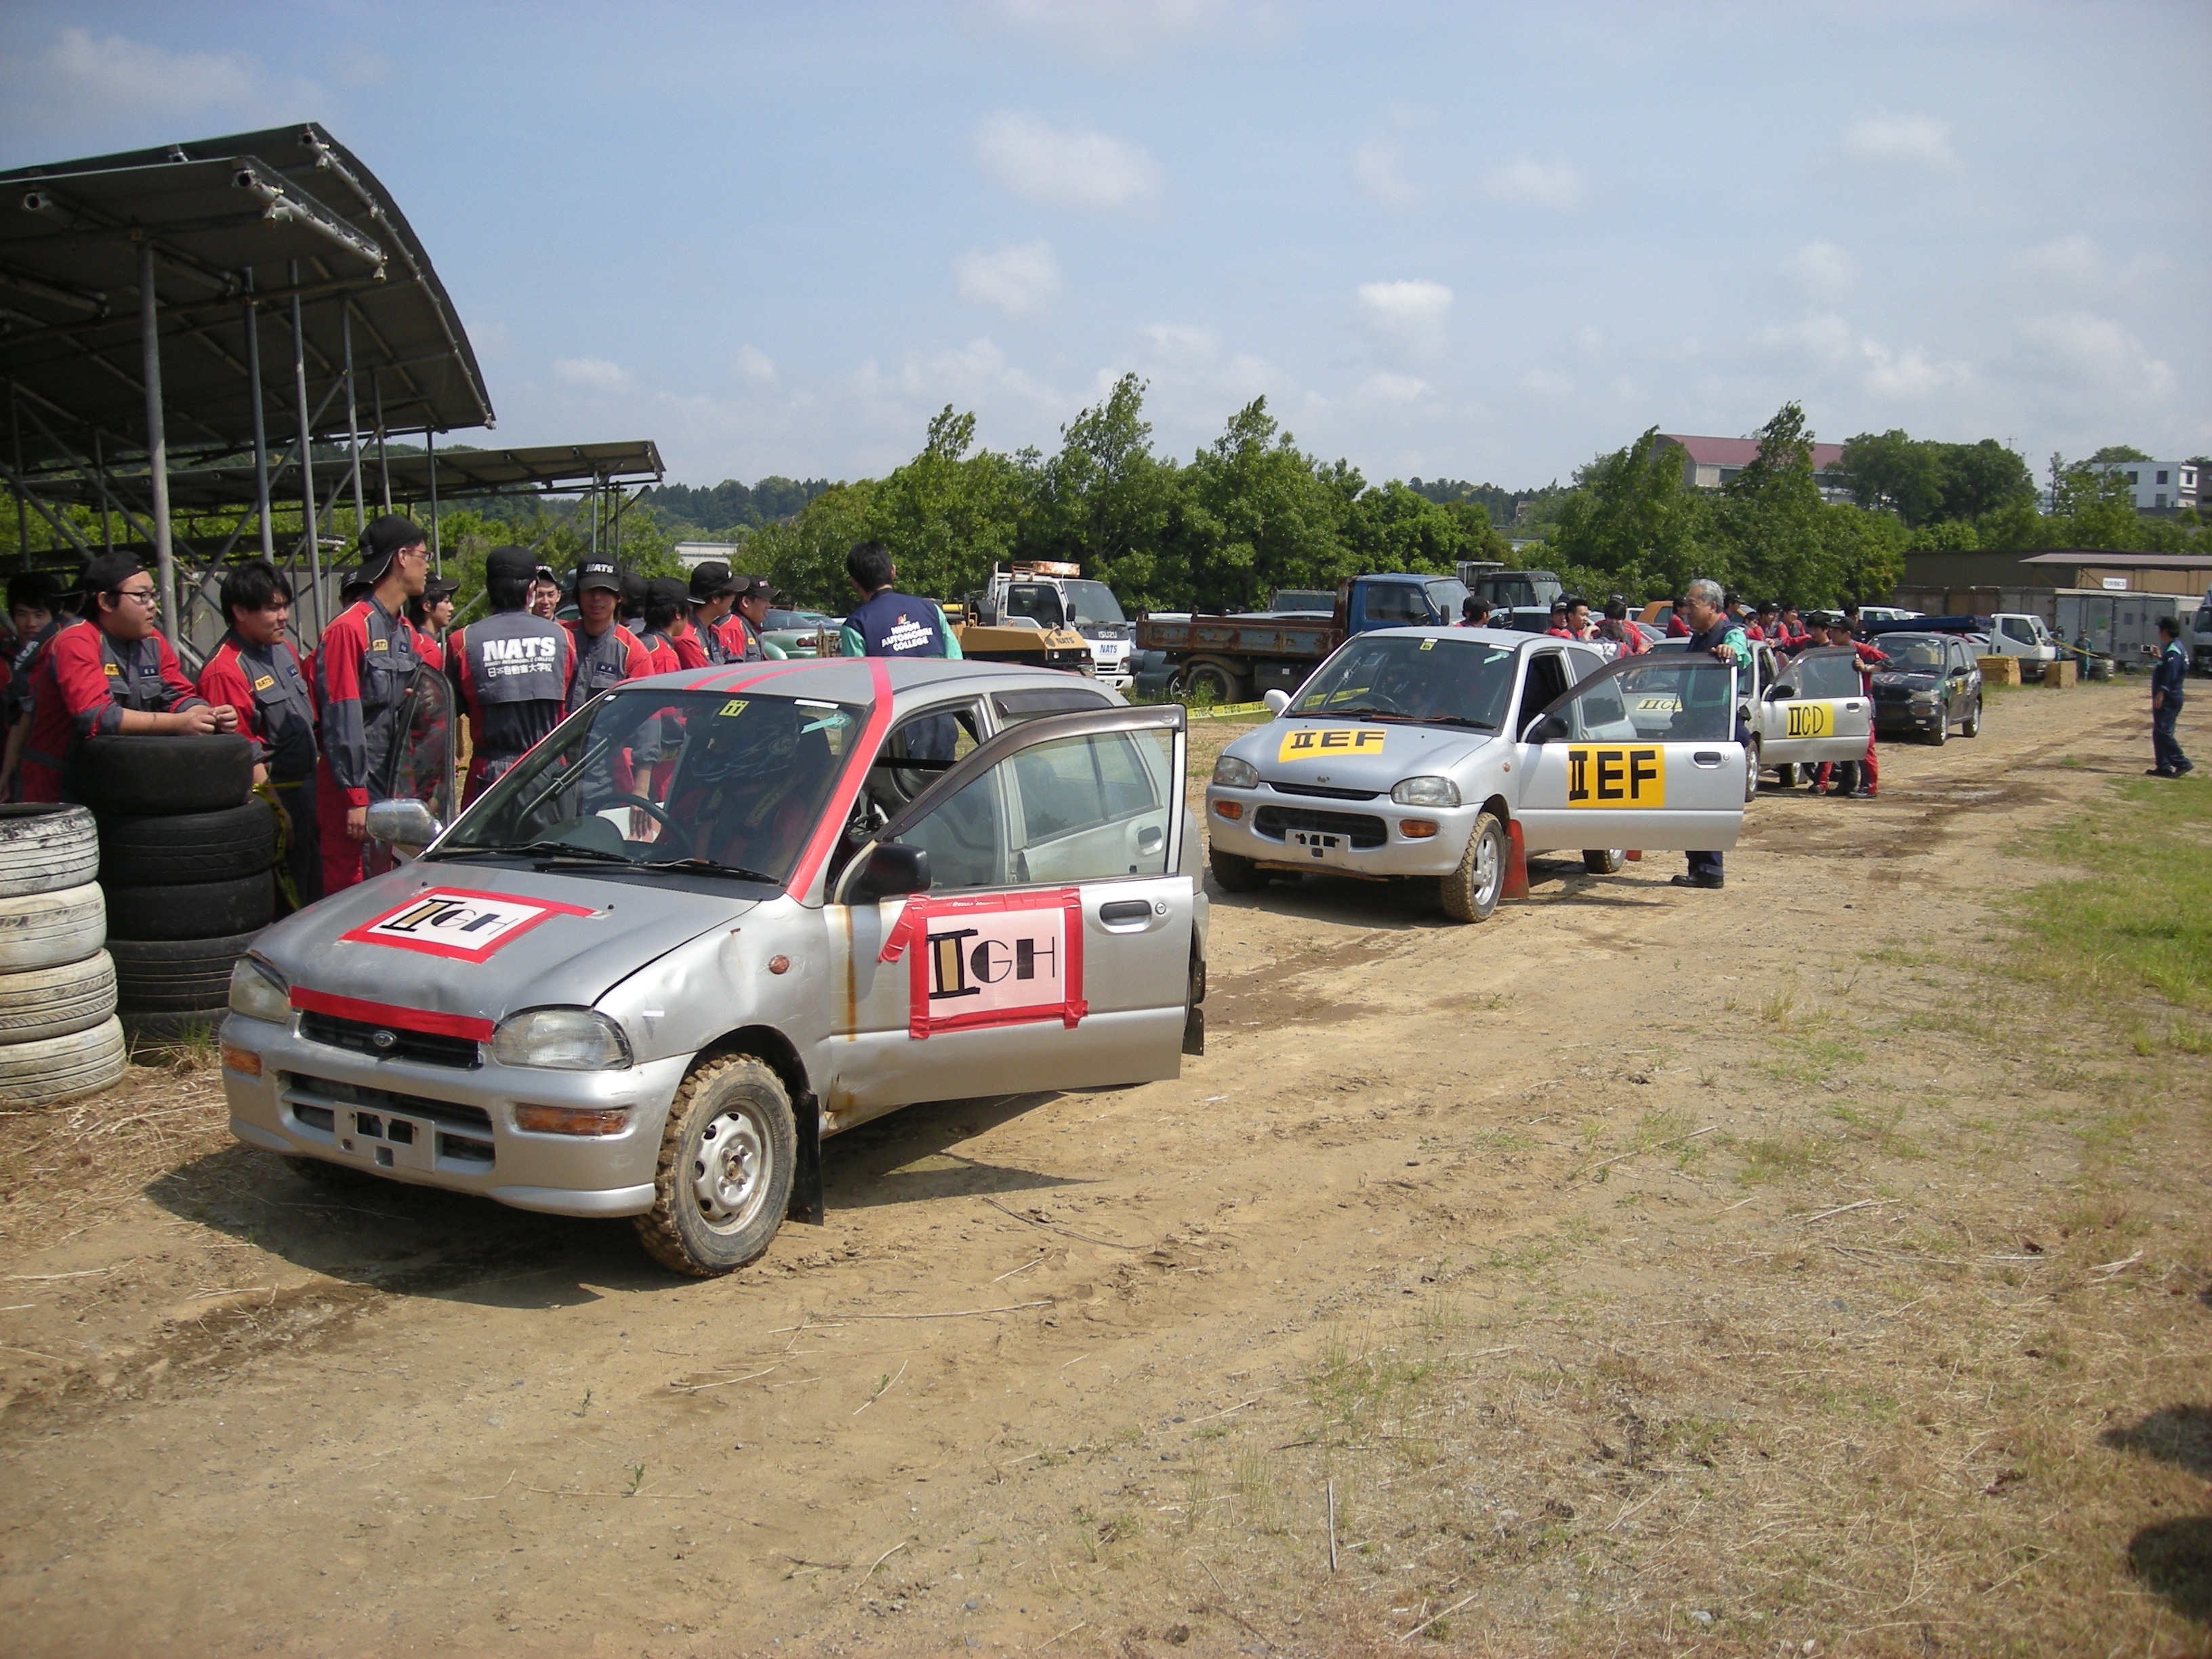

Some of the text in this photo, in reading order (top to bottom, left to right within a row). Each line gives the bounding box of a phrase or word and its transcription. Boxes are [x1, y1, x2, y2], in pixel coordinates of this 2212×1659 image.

[586, 564, 614, 573] NATS
[890, 621, 920, 635] NIHON
[483, 637, 556, 662] NATS
[893, 636, 929, 651] COLLEGE
[1099, 644, 1118, 653] NATS
